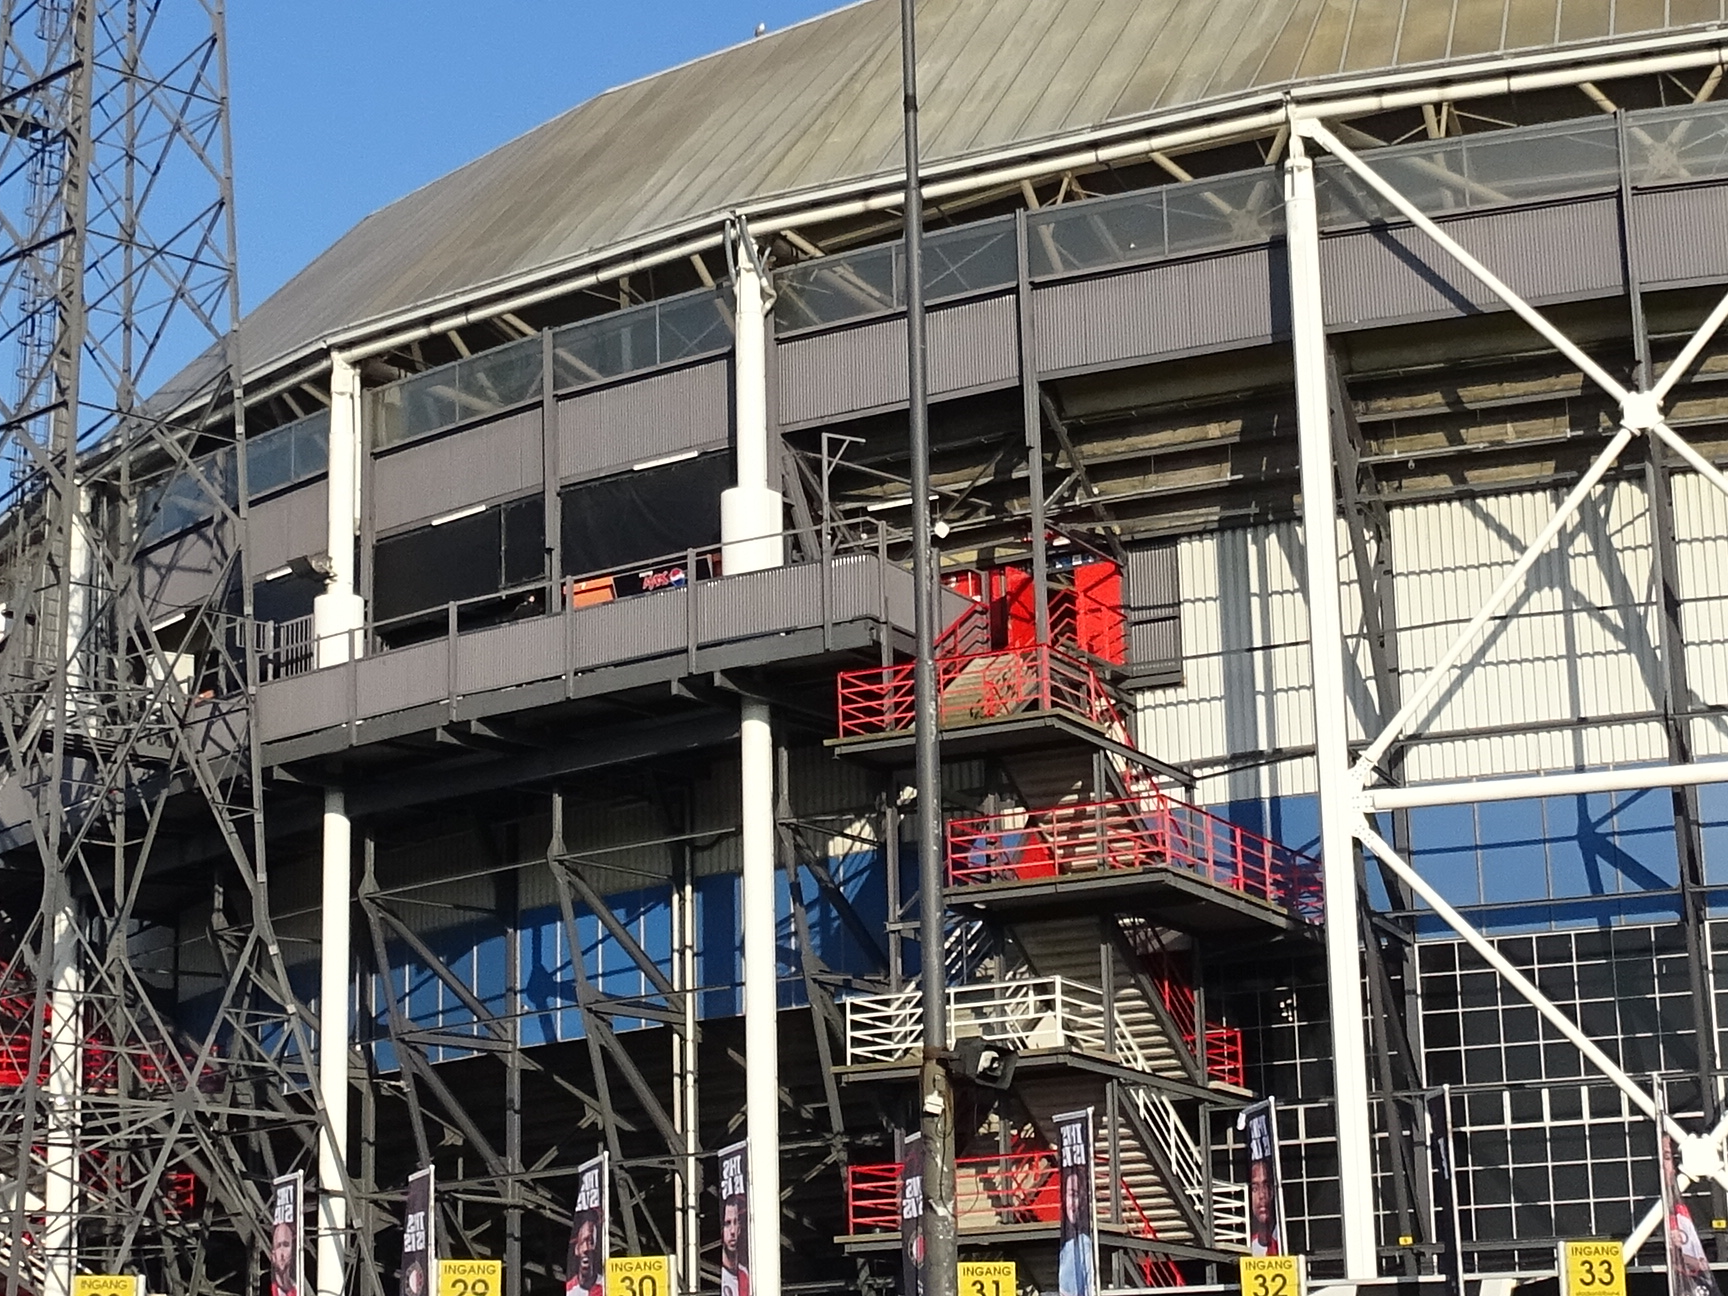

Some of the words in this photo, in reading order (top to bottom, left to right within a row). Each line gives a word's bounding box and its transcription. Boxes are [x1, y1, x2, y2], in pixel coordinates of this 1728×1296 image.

[1571, 1245, 1619, 1257] INGANG
[444, 1264, 496, 1275] INGANG
[611, 1260, 662, 1273] INGANG
[962, 1265, 1011, 1277] INGANG
[1245, 1259, 1292, 1271] INGANG
[1579, 1259, 1615, 1286] 33
[81, 1279, 128, 1290] INGANG
